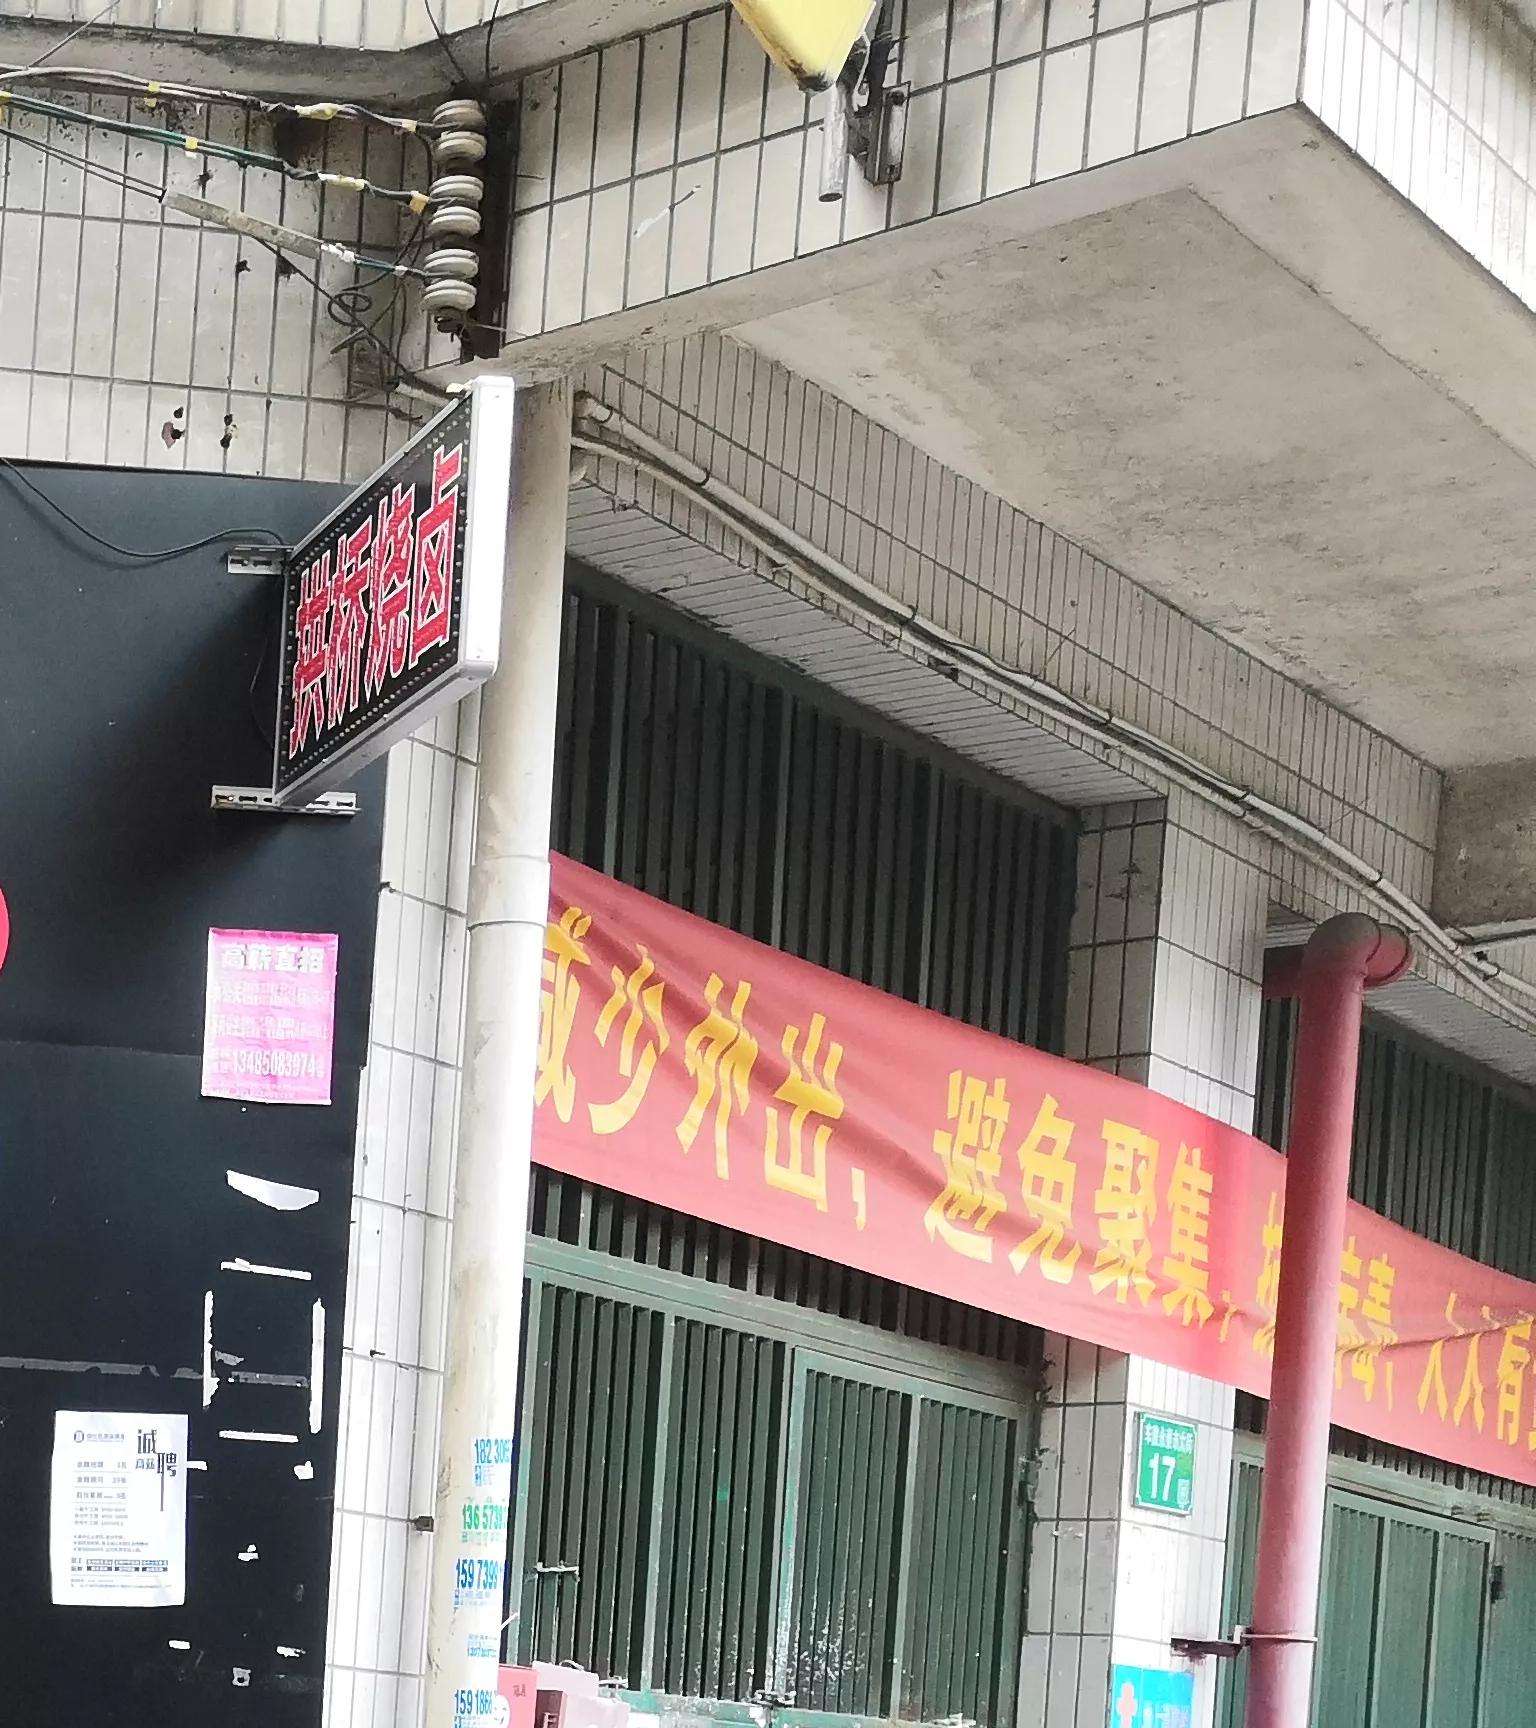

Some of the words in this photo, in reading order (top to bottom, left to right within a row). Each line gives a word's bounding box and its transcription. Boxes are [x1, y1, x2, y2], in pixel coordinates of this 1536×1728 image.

[289, 444, 463, 760] 拱桥烧卤
[1149, 1452, 1176, 1502] 17
